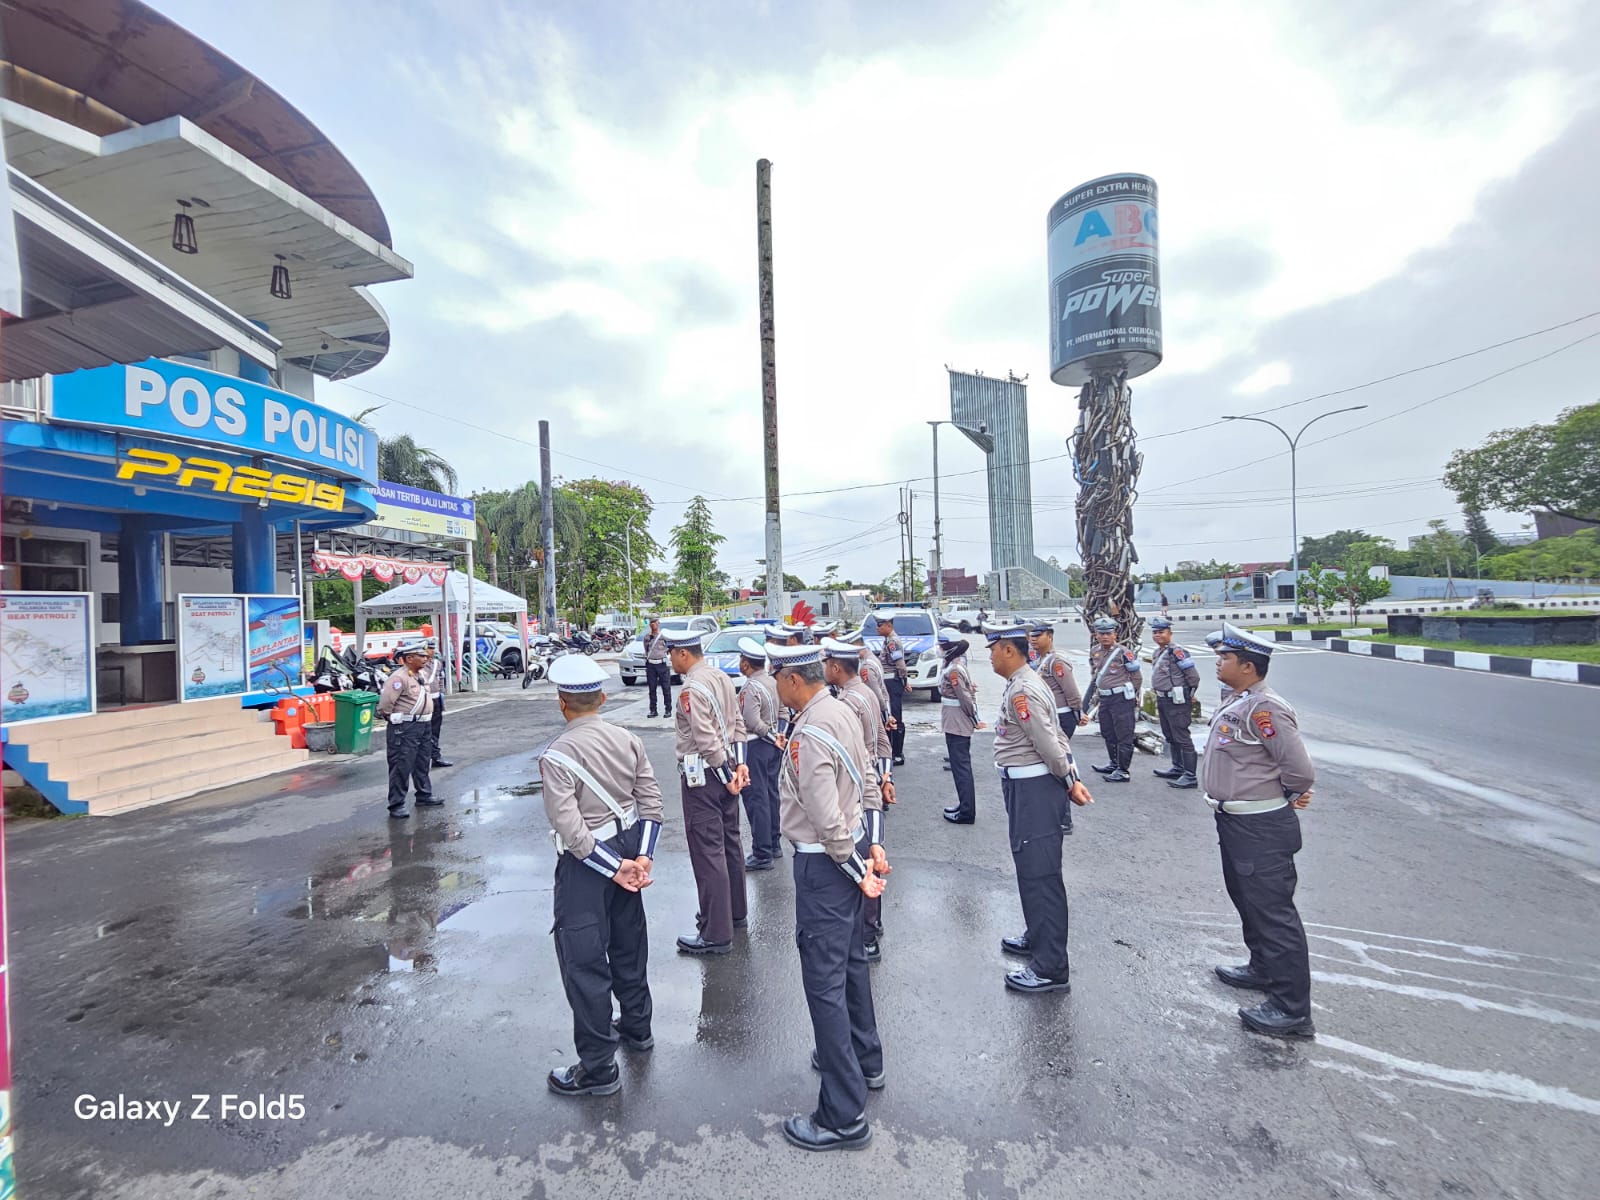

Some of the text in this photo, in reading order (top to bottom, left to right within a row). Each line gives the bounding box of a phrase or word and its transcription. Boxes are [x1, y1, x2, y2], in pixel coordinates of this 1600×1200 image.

[1063, 189, 1094, 209] SUPER
[1096, 182, 1129, 194] EXTRA
[1101, 268, 1152, 284] Super
[1075, 327, 1127, 345] INTERNATIONAL
[1128, 326, 1155, 336] CHEMICAL
[1096, 337, 1115, 347] MADE
[125, 365, 365, 470] POS POLISI
[116, 448, 346, 512] PRESISI
[397, 491, 421, 504] TERTIB
[421, 495, 438, 507] LALU
[438, 500, 458, 512] LINTAS
[249, 634, 299, 656] SATLANTAS
